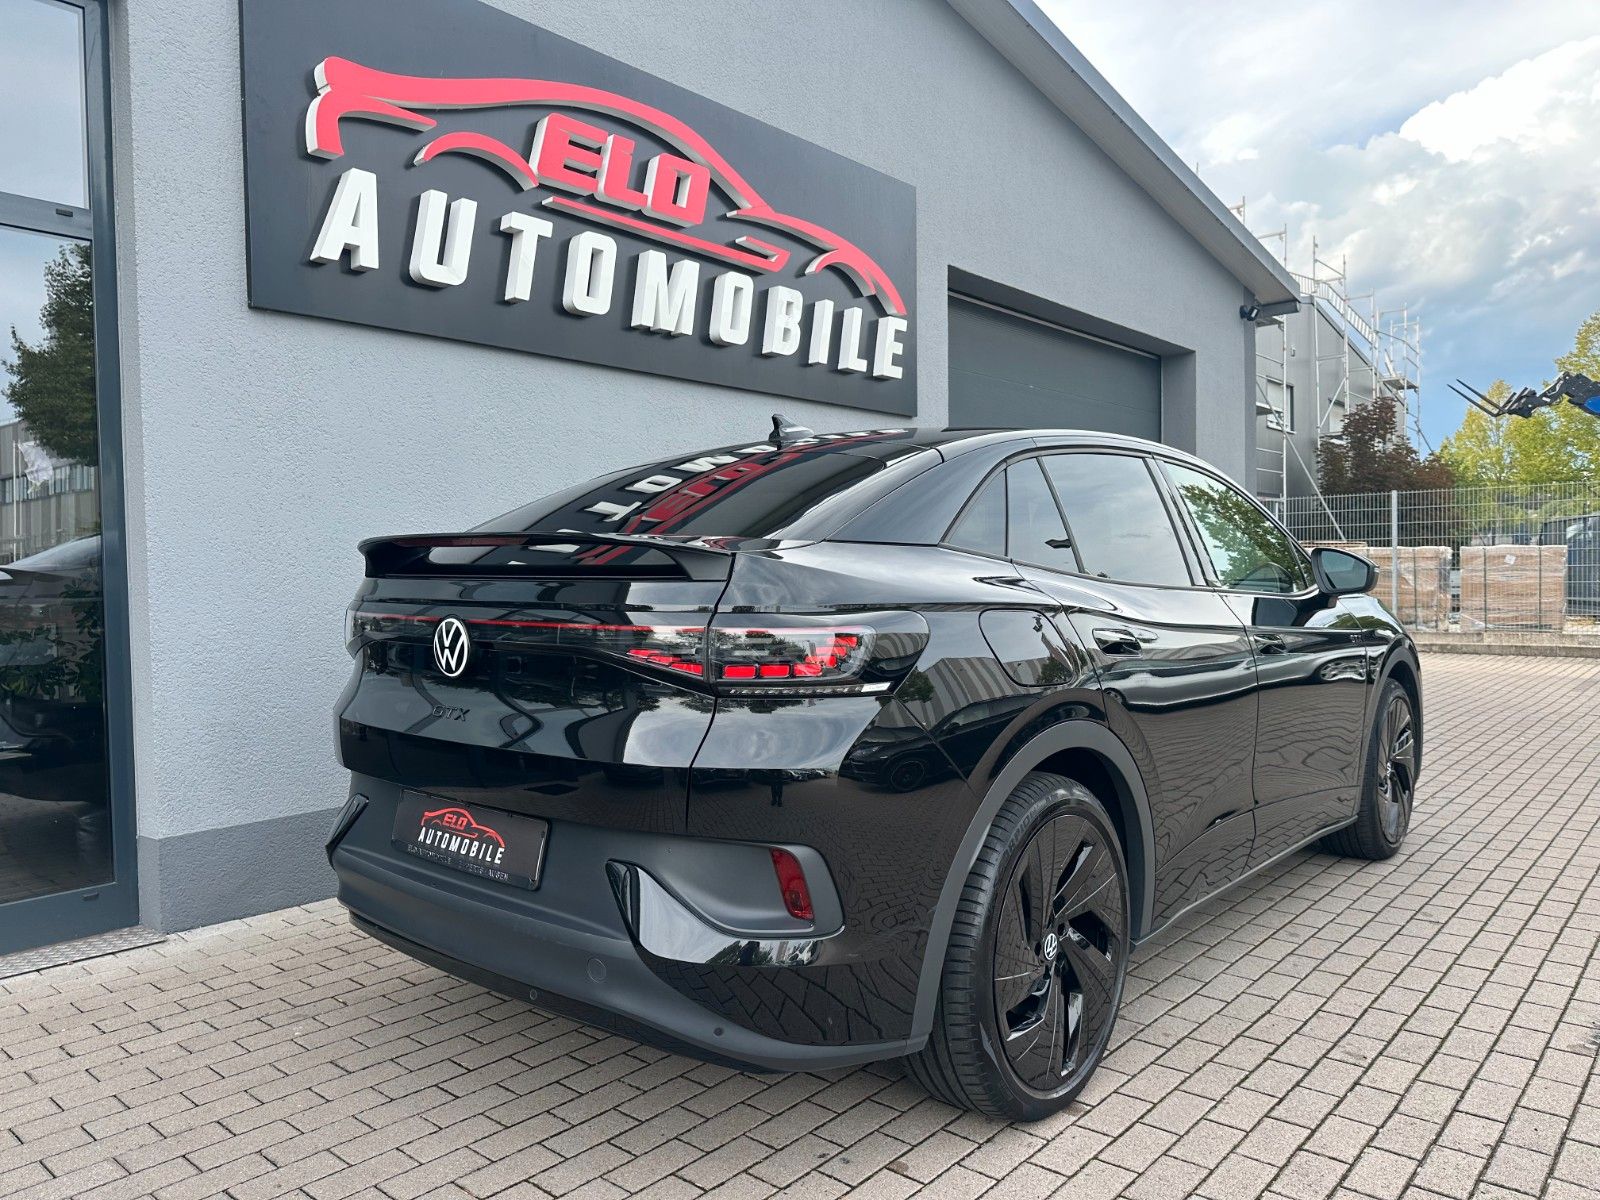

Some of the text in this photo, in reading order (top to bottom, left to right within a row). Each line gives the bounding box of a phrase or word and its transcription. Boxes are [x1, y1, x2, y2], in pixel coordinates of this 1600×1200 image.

[310, 168, 908, 380] AUTOMOBILE
[432, 704, 470, 722] GTX
[418, 826, 505, 864] AUTOMOBILE
